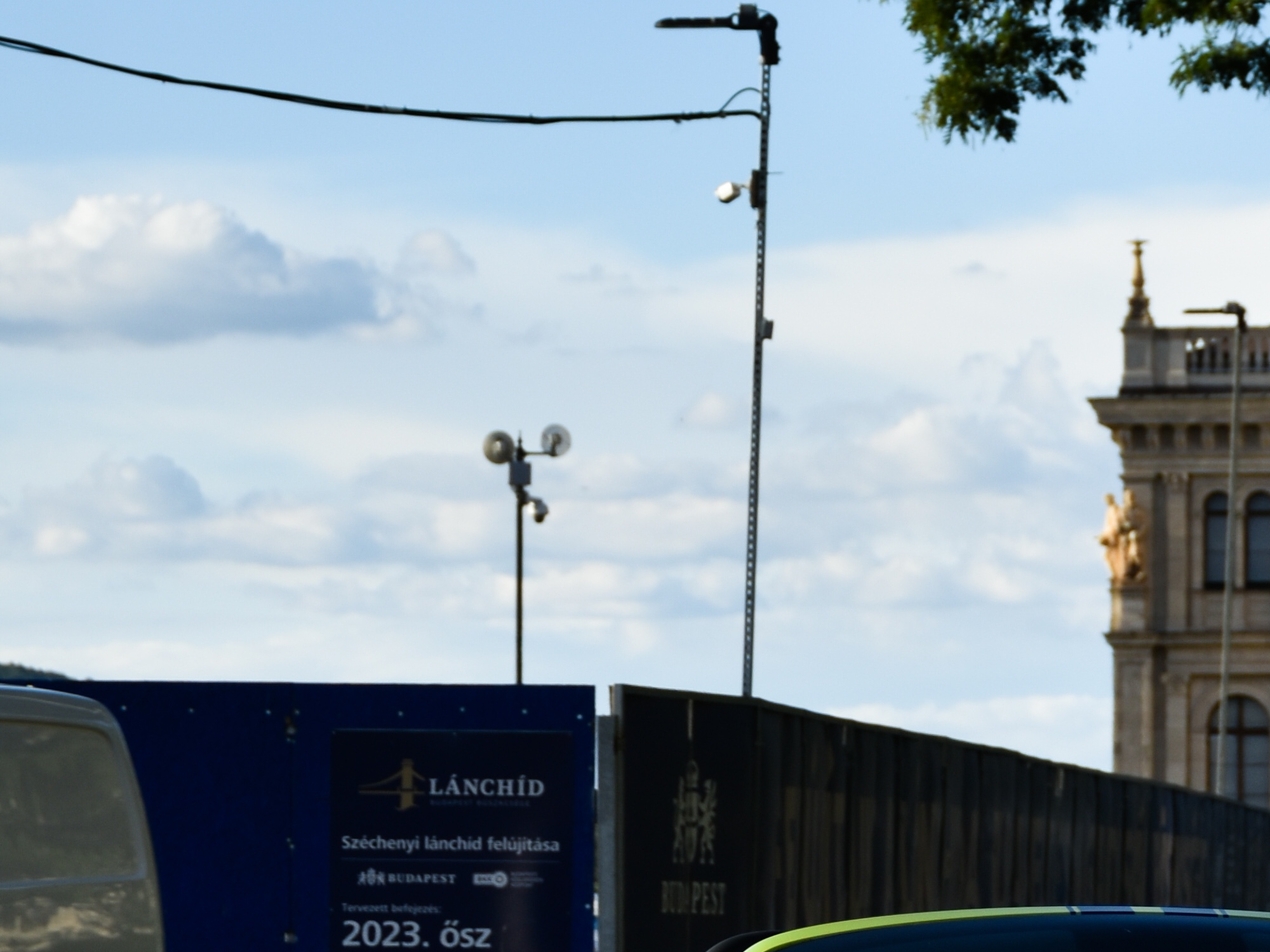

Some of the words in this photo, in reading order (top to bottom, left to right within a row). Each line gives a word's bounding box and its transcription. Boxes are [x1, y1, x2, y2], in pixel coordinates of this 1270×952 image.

[429, 774, 546, 796] LÁNCHÍD
[341, 836, 420, 854] Széchenyi
[424, 836, 483, 851] lánchíd
[487, 836, 561, 855] felújítása
[388, 873, 456, 884] BUDAPEST
[341, 903, 389, 913] Tervezett
[341, 920, 430, 948] 2023.
[439, 919, 493, 948] ősz
